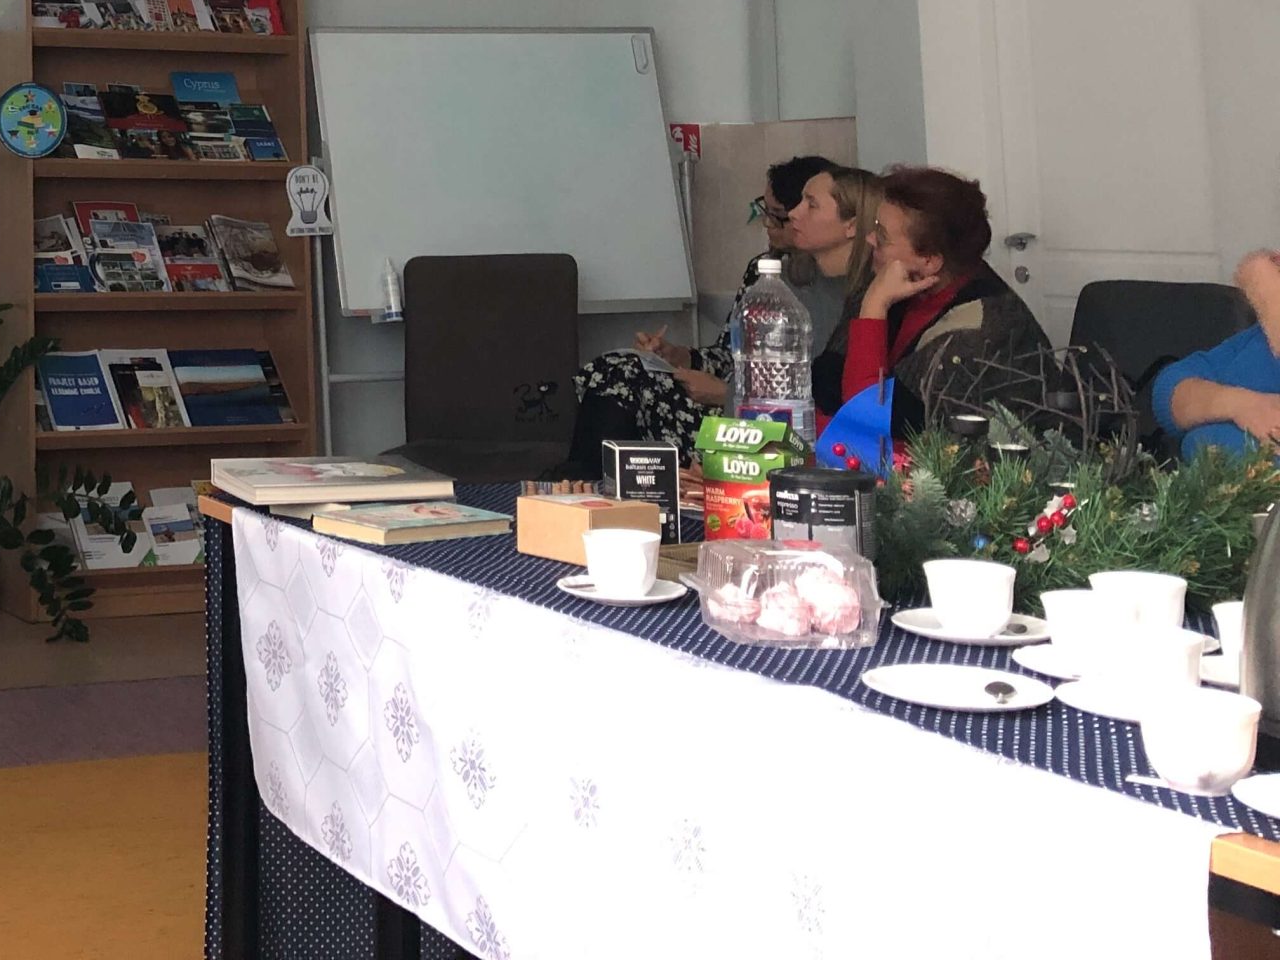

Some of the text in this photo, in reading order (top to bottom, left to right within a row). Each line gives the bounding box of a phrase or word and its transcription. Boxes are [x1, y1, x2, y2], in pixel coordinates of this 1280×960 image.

[183, 78, 221, 91] Cyprus
[48, 376, 100, 387] PROJECT BASED
[715, 423, 763, 445] LOYD
[789, 432, 804, 452] LOYD
[723, 456, 760, 477] LOYD
[790, 456, 804, 468] LOYD
[636, 474, 656, 486] WHITE
[705, 486, 725, 497] WARM
[706, 494, 742, 507] RASPBERRY
